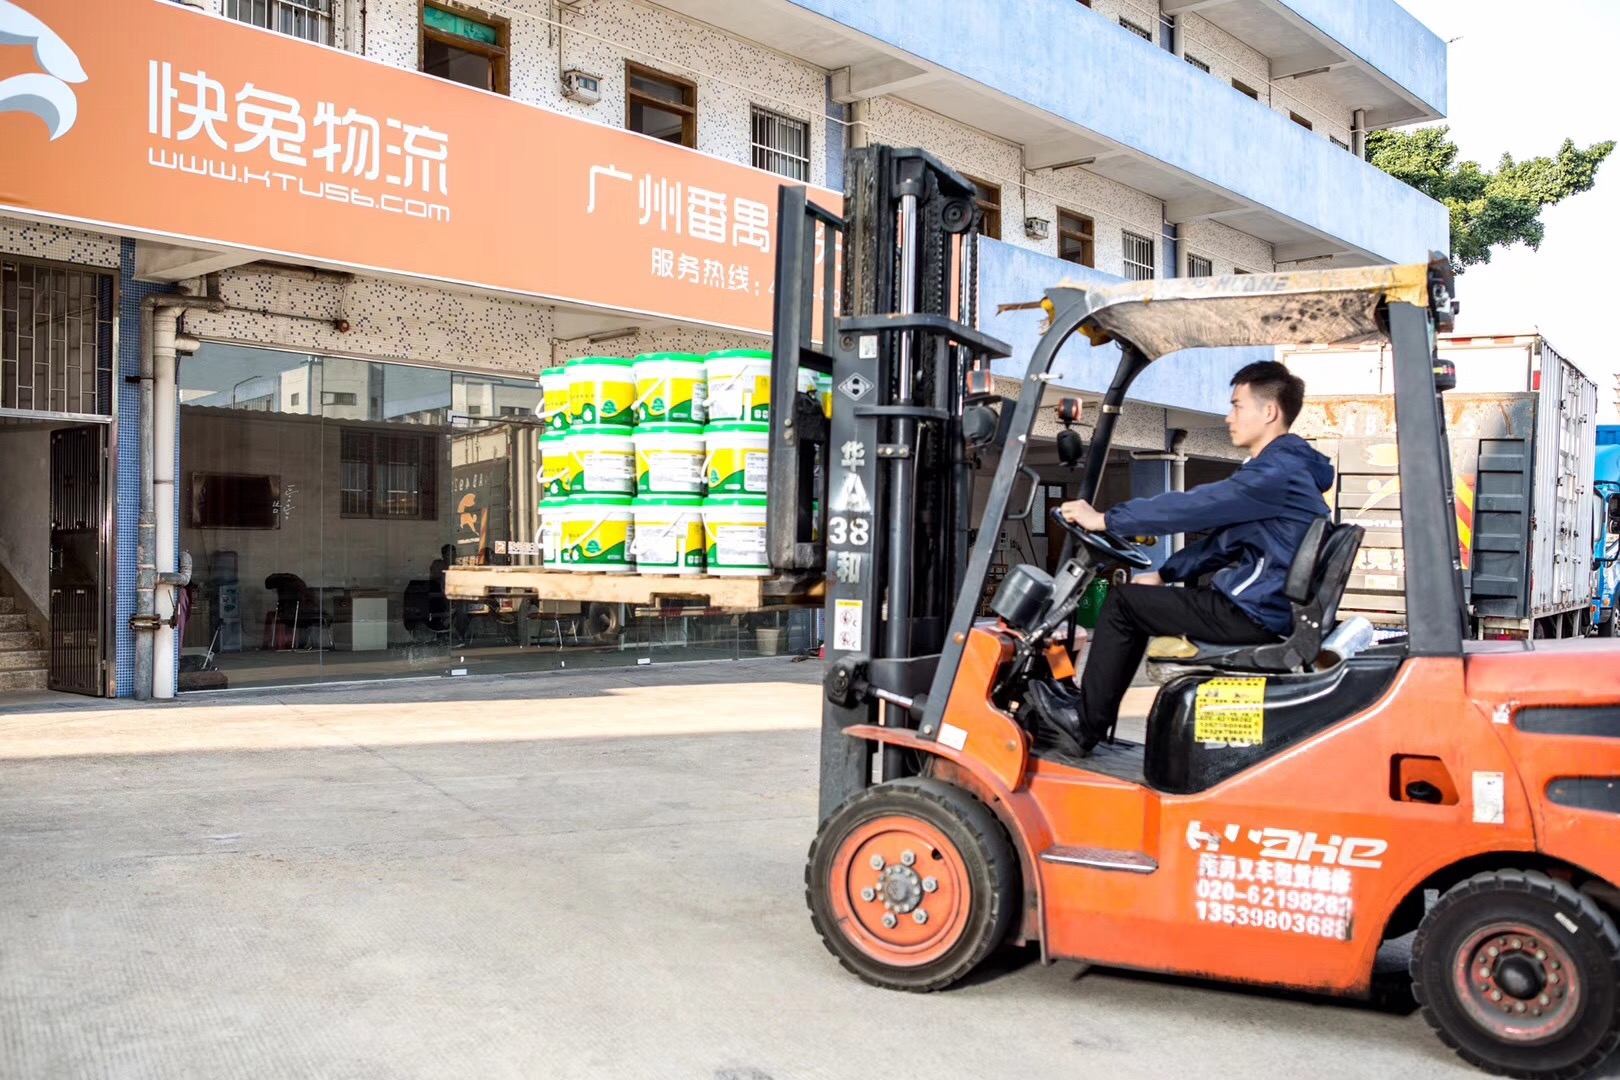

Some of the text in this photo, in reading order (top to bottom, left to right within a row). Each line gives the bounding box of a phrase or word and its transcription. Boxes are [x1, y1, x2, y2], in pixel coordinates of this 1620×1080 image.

[148, 60, 449, 196] 快兔物流
[829, 516, 869, 546] 38
